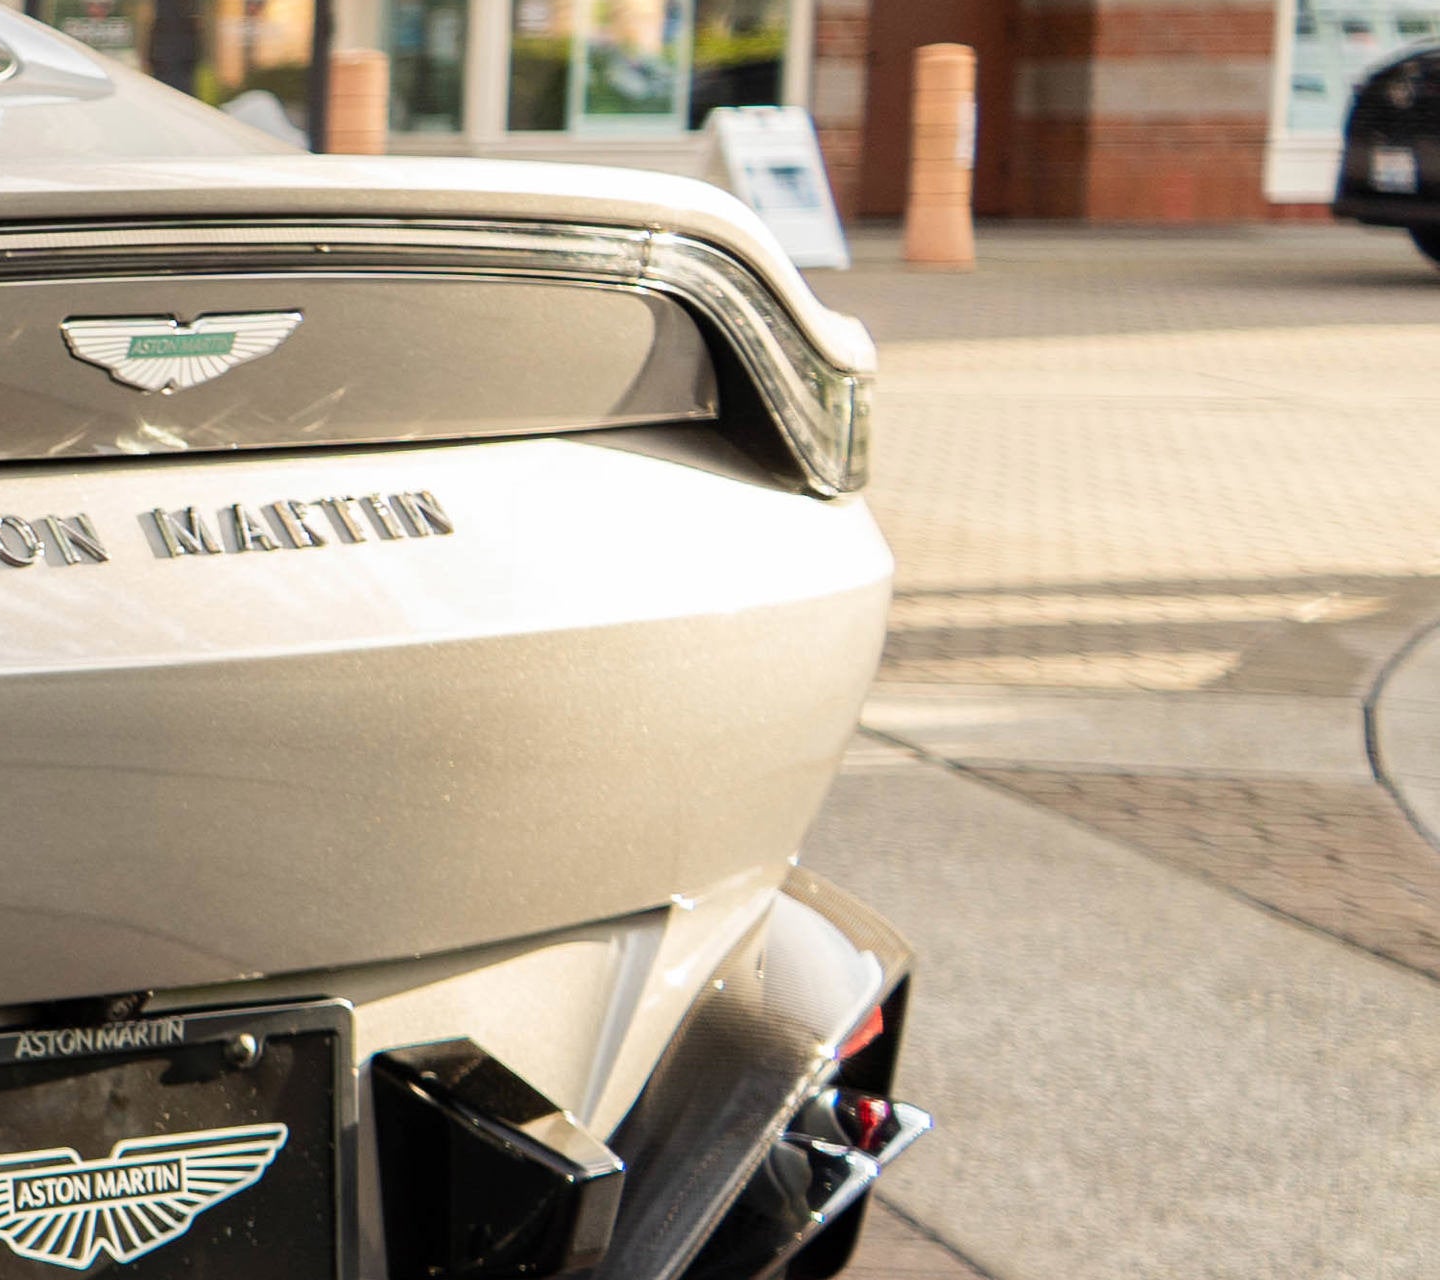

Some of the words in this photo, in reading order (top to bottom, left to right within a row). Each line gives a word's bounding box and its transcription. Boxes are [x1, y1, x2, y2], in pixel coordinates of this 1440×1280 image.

[151, 489, 455, 558] MARTIN
[15, 1026, 94, 1059] ASTON
[95, 1018, 185, 1051] MARTIN
[16, 1174, 94, 1211] ASTON
[95, 1163, 180, 1200] MARTIN
